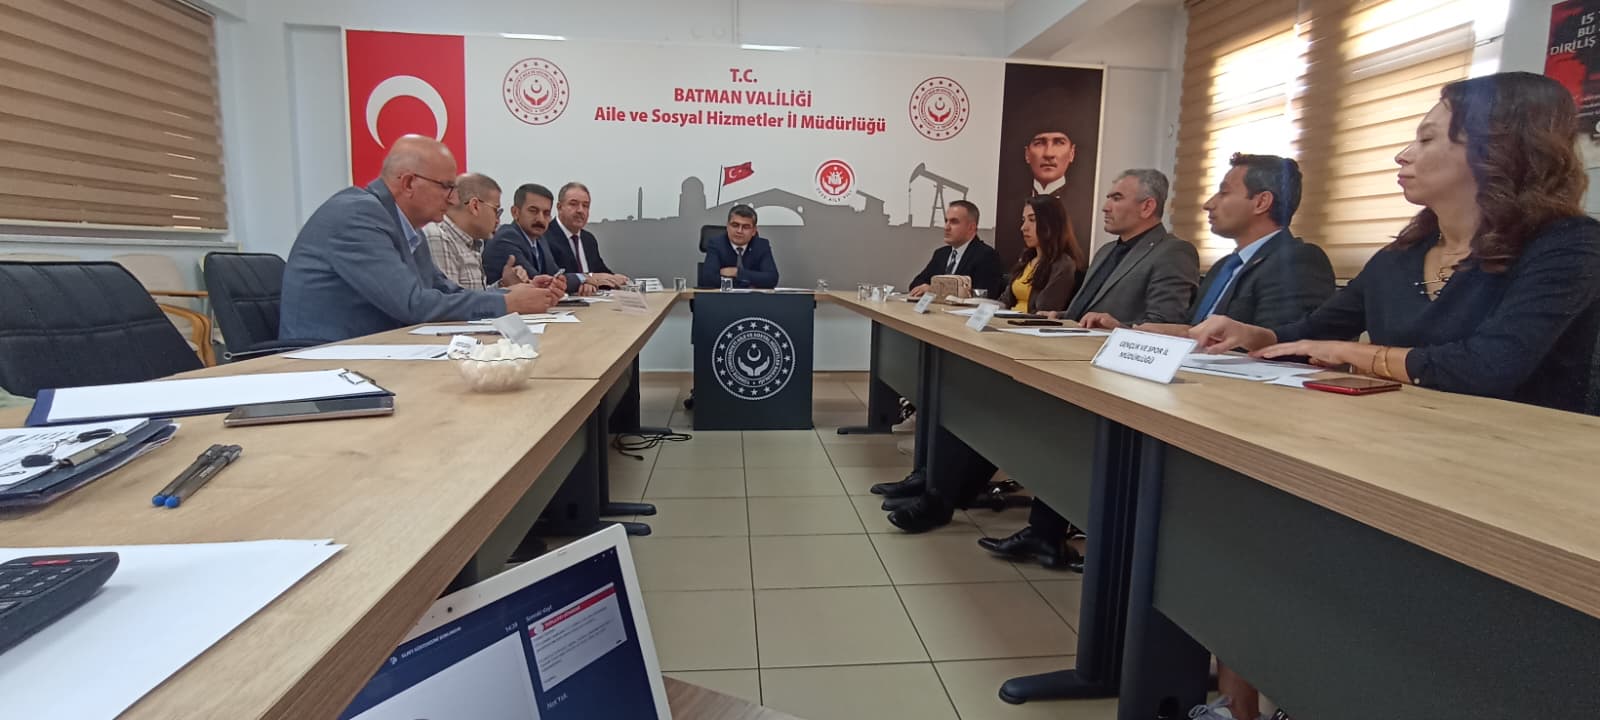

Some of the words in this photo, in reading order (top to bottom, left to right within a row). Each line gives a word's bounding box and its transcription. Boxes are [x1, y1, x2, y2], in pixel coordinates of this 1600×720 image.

[1577, 24, 1596, 38] BU
[1550, 36, 1597, 56] DİRİLİŞ
[729, 67, 758, 83] T.C.
[673, 87, 742, 104] BATMAN
[745, 88, 812, 107] VALİLİĞİ
[594, 106, 626, 121] Aile
[629, 111, 648, 122] ve
[651, 108, 703, 127] Sosyal
[706, 110, 784, 128] Hizmetler
[787, 111, 797, 129] İl
[800, 115, 886, 135] Müdürlüğü
